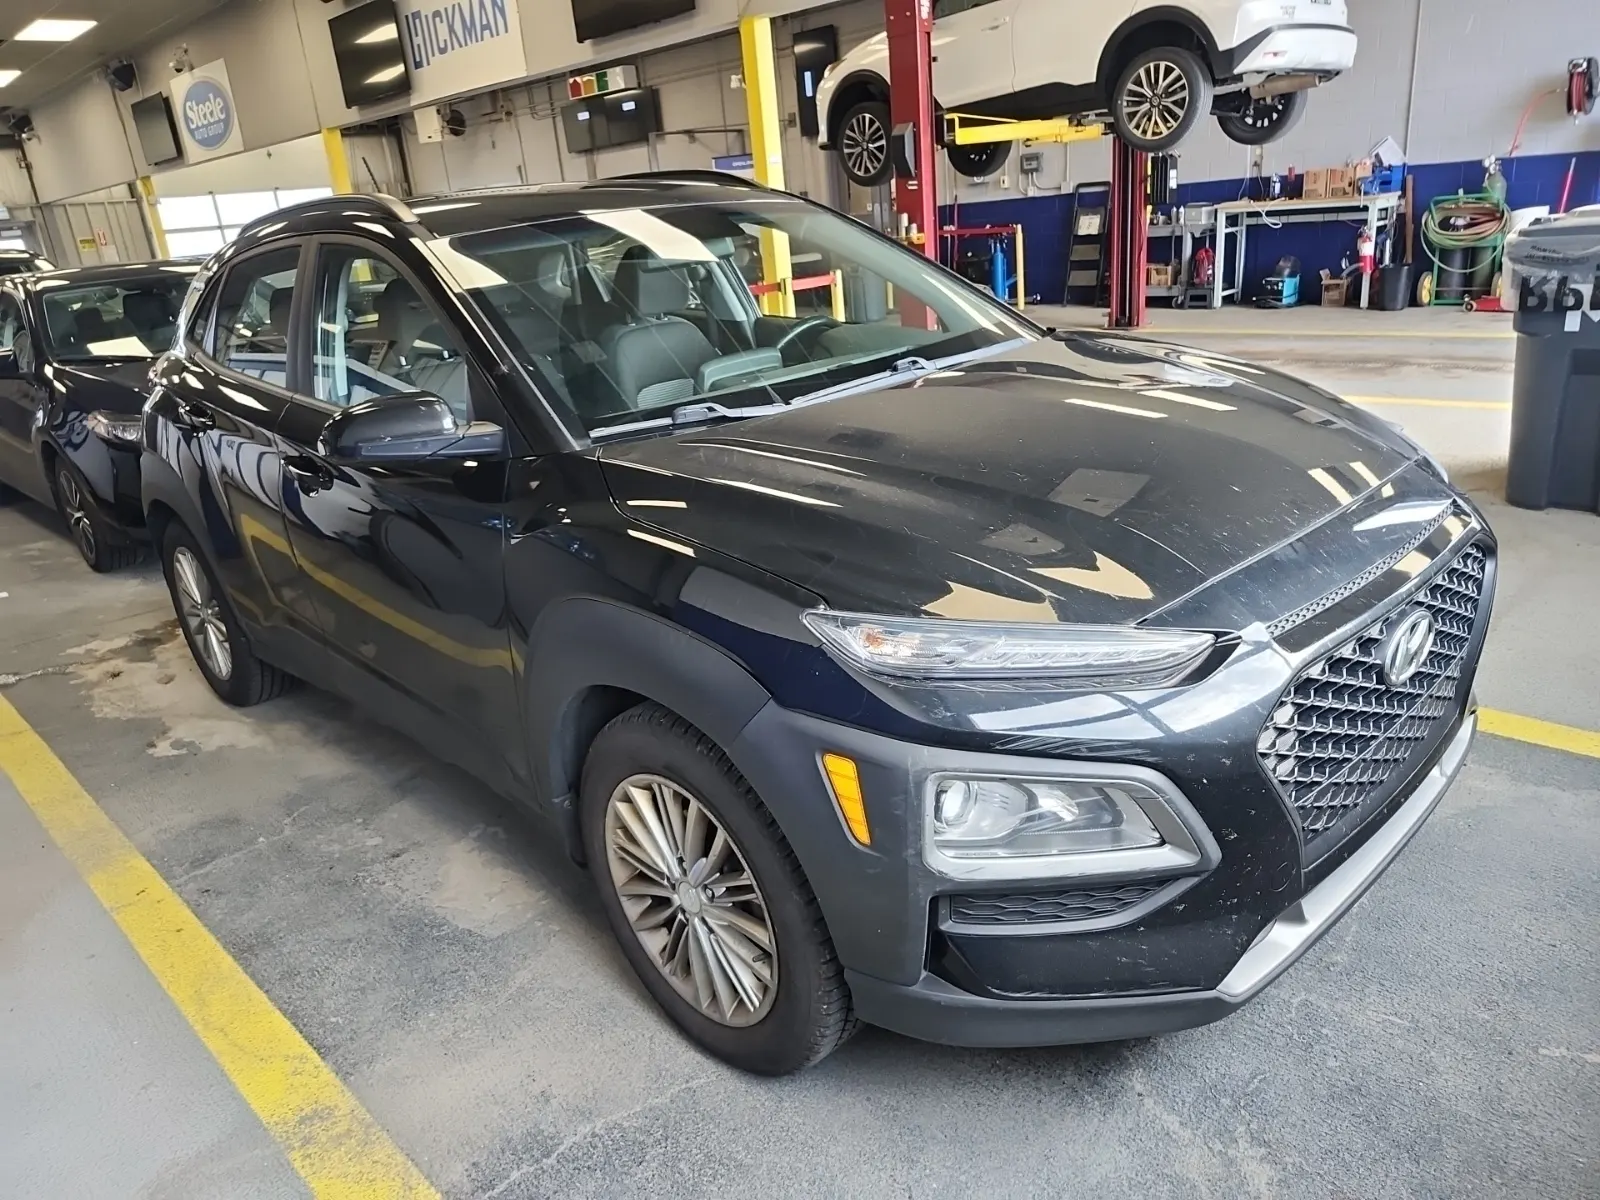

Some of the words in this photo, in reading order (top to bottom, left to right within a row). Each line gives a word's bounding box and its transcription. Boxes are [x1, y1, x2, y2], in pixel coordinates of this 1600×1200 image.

[405, 0, 508, 70] HICKMAN
[186, 92, 226, 129] Steele
[194, 128, 207, 140] AUTO
[208, 122, 225, 136] GROUP
